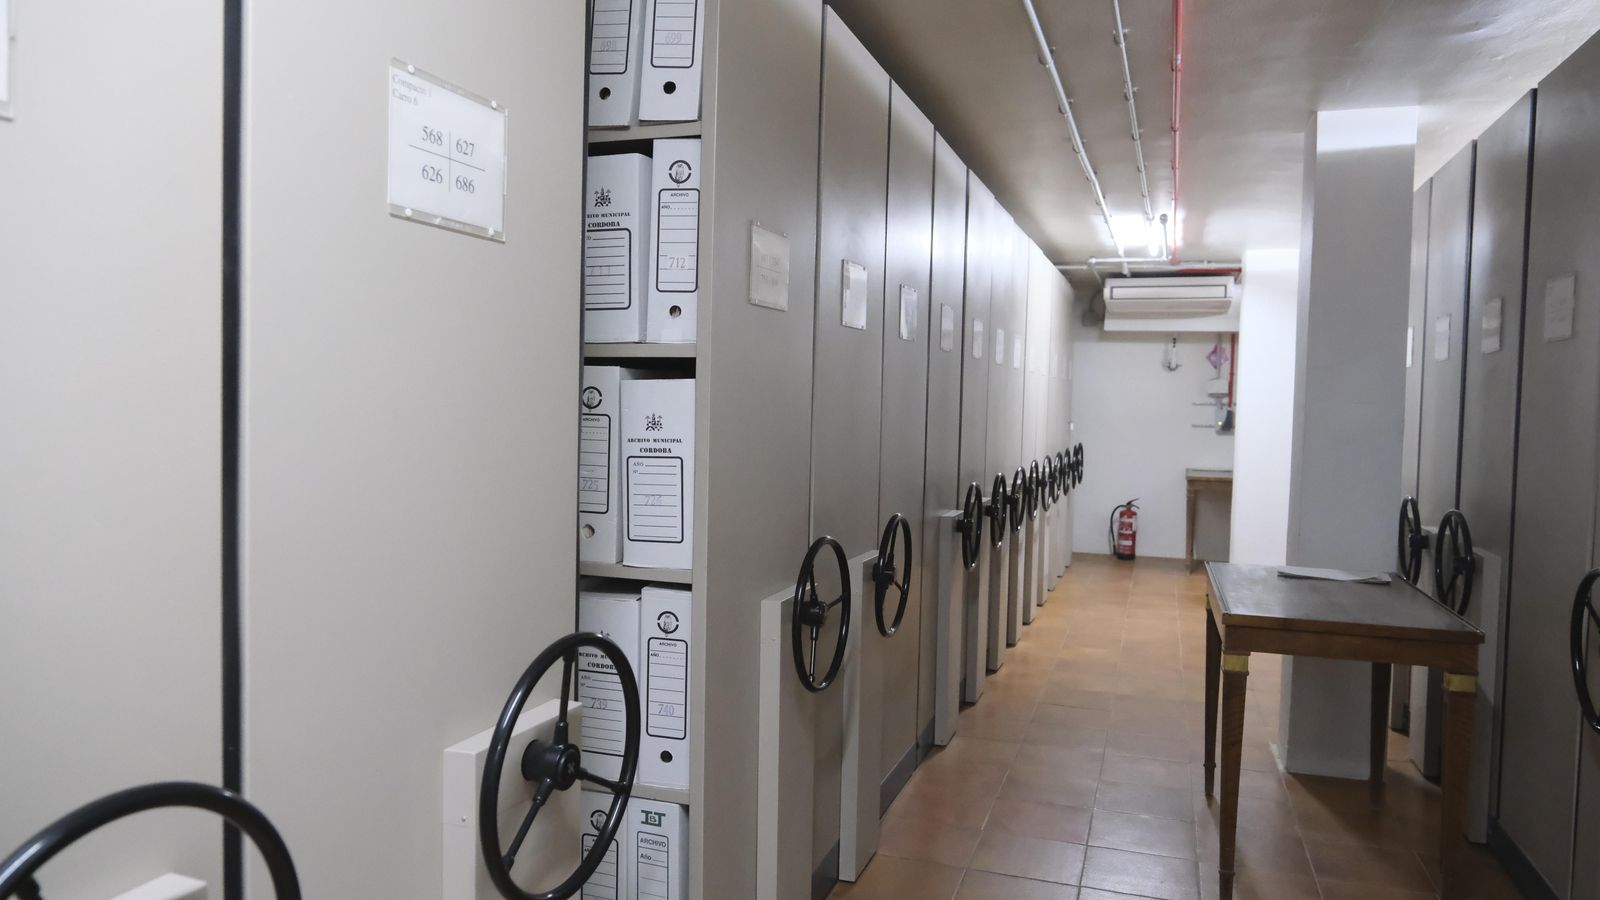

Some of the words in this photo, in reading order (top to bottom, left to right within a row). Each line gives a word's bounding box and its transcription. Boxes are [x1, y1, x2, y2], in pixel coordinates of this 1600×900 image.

[422, 126, 443, 146] 568
[456, 139, 475, 157] 627
[422, 164, 443, 185] 626
[456, 176, 475, 194] 686
[587, 221, 620, 229] CORDOBA
[669, 256, 686, 269] 712
[582, 479, 599, 490] 725
[657, 703, 675, 716] 740
[639, 837, 667, 849] ARCHIVO
[639, 852, 652, 862] Año
